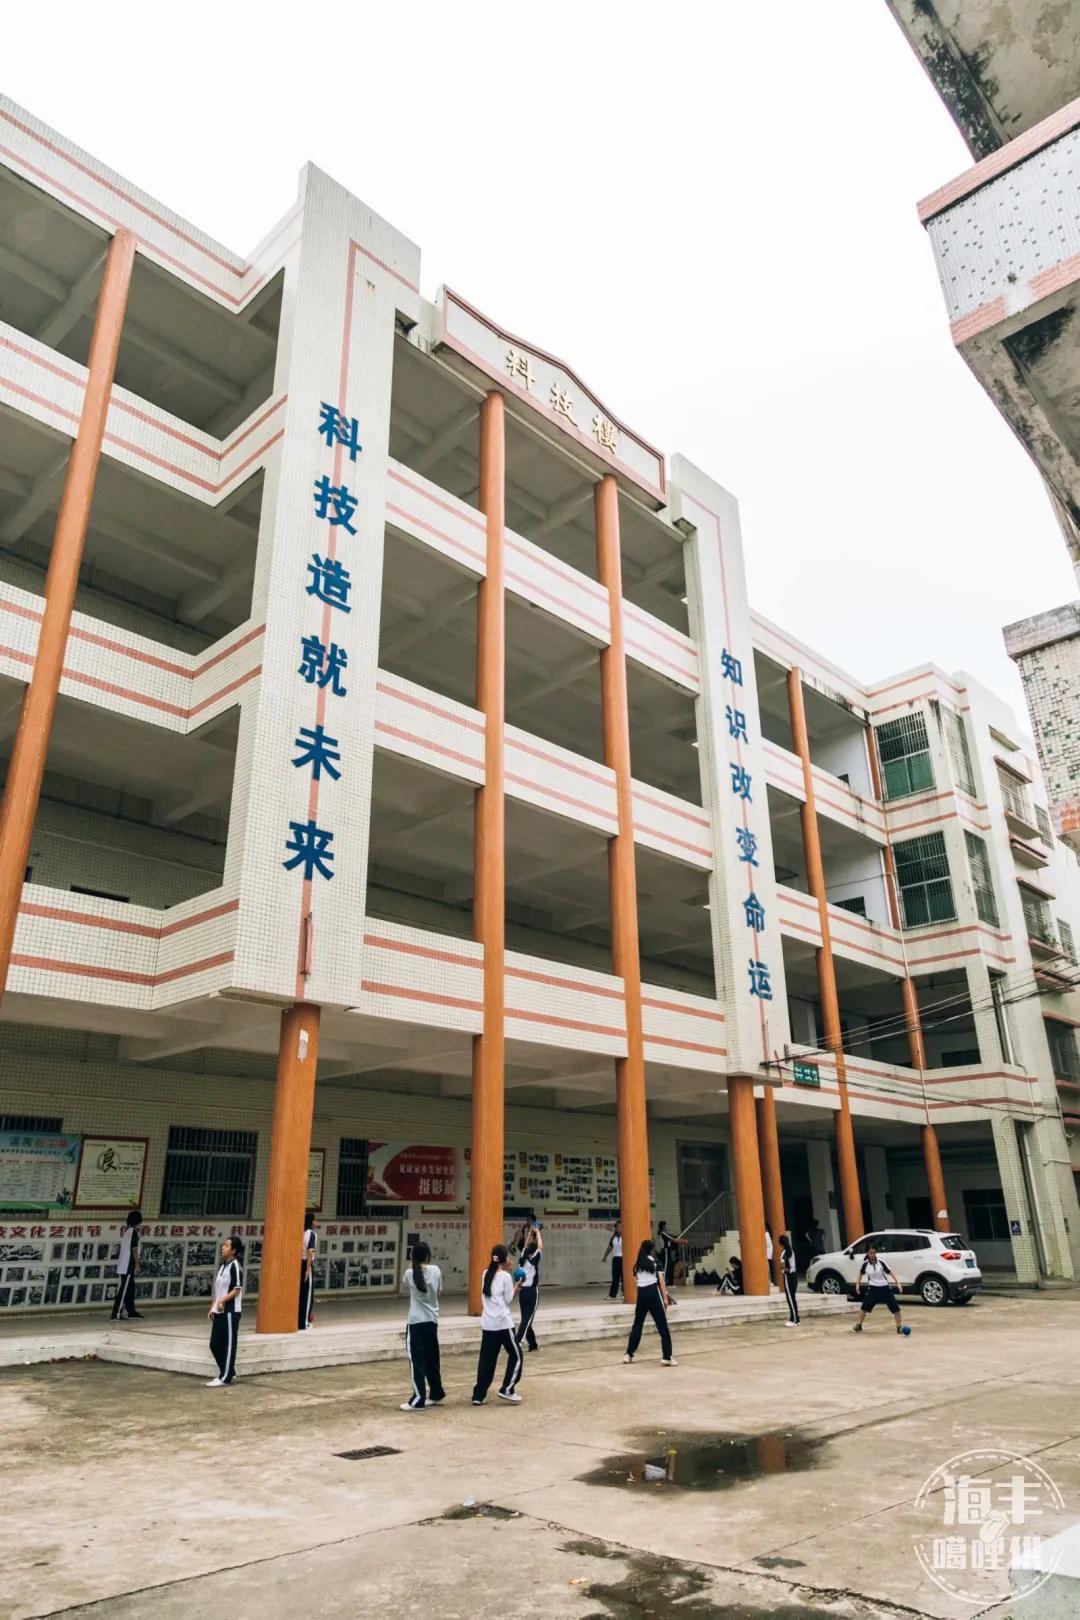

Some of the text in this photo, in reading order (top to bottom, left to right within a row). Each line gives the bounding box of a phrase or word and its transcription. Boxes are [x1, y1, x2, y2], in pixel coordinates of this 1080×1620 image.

[281, 401, 363, 882] 科技造就未来
[721, 647, 774, 1001] 知识改变命运
